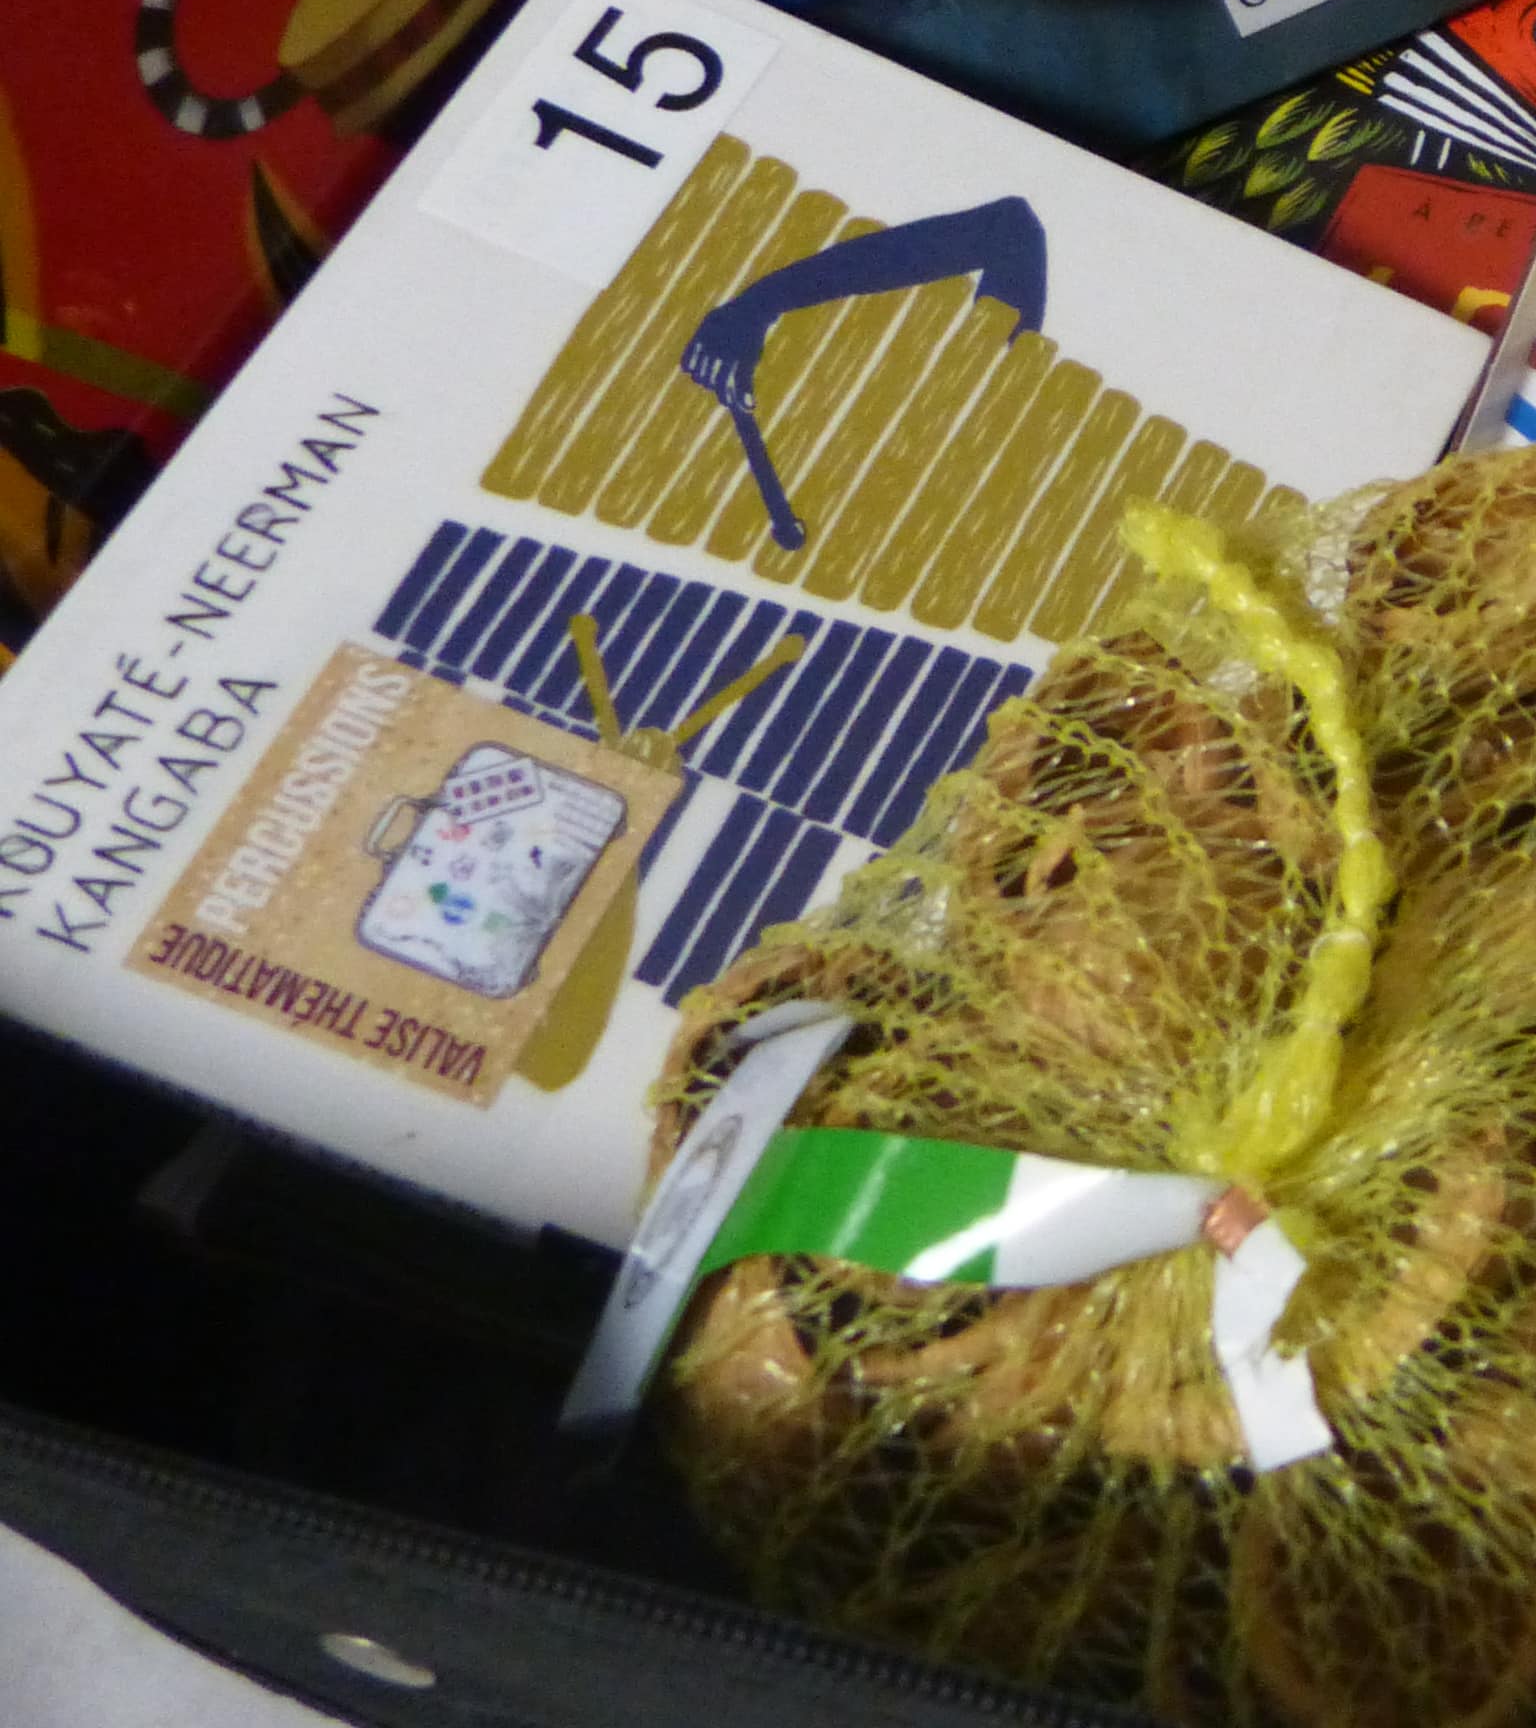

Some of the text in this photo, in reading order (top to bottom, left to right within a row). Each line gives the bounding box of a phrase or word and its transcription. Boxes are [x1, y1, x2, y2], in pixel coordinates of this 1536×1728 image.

[531, 6, 724, 169] 15
[36, 673, 279, 955] KANGABA
[195, 662, 413, 938] PERCUSSIONS
[149, 922, 487, 1086] VALISE THÉMATIQUE
